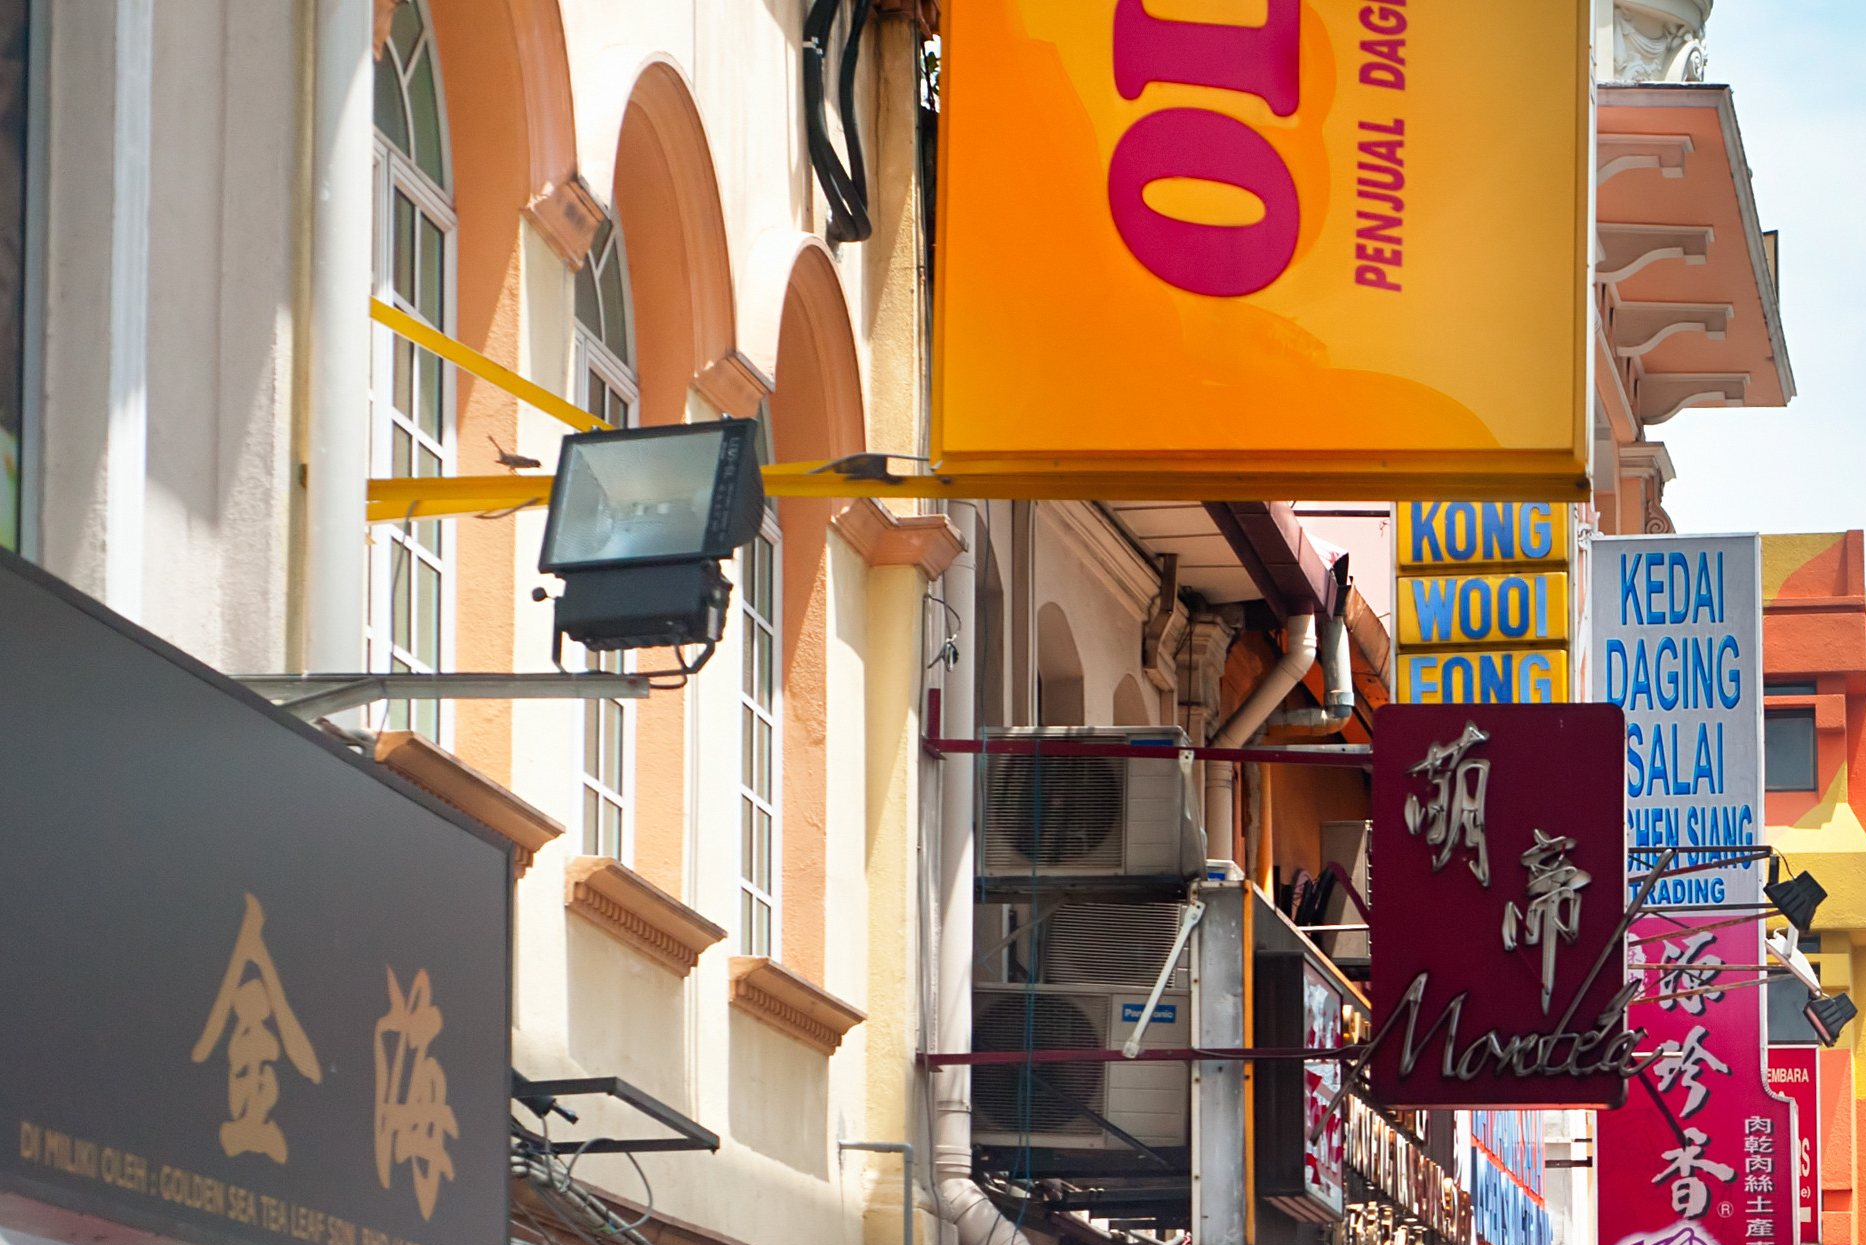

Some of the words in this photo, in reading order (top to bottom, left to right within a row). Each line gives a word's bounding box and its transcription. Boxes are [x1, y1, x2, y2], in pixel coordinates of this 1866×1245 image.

[1354, 117, 1406, 293] PENJUAL
[1411, 502, 1552, 563] KONG
[1411, 577, 1547, 642] WOOI
[1620, 552, 1725, 626] KEDAI
[1606, 635, 1741, 710] DAGING
[1628, 722, 1725, 798] SALAI
[1687, 804, 1753, 870] SIANG
